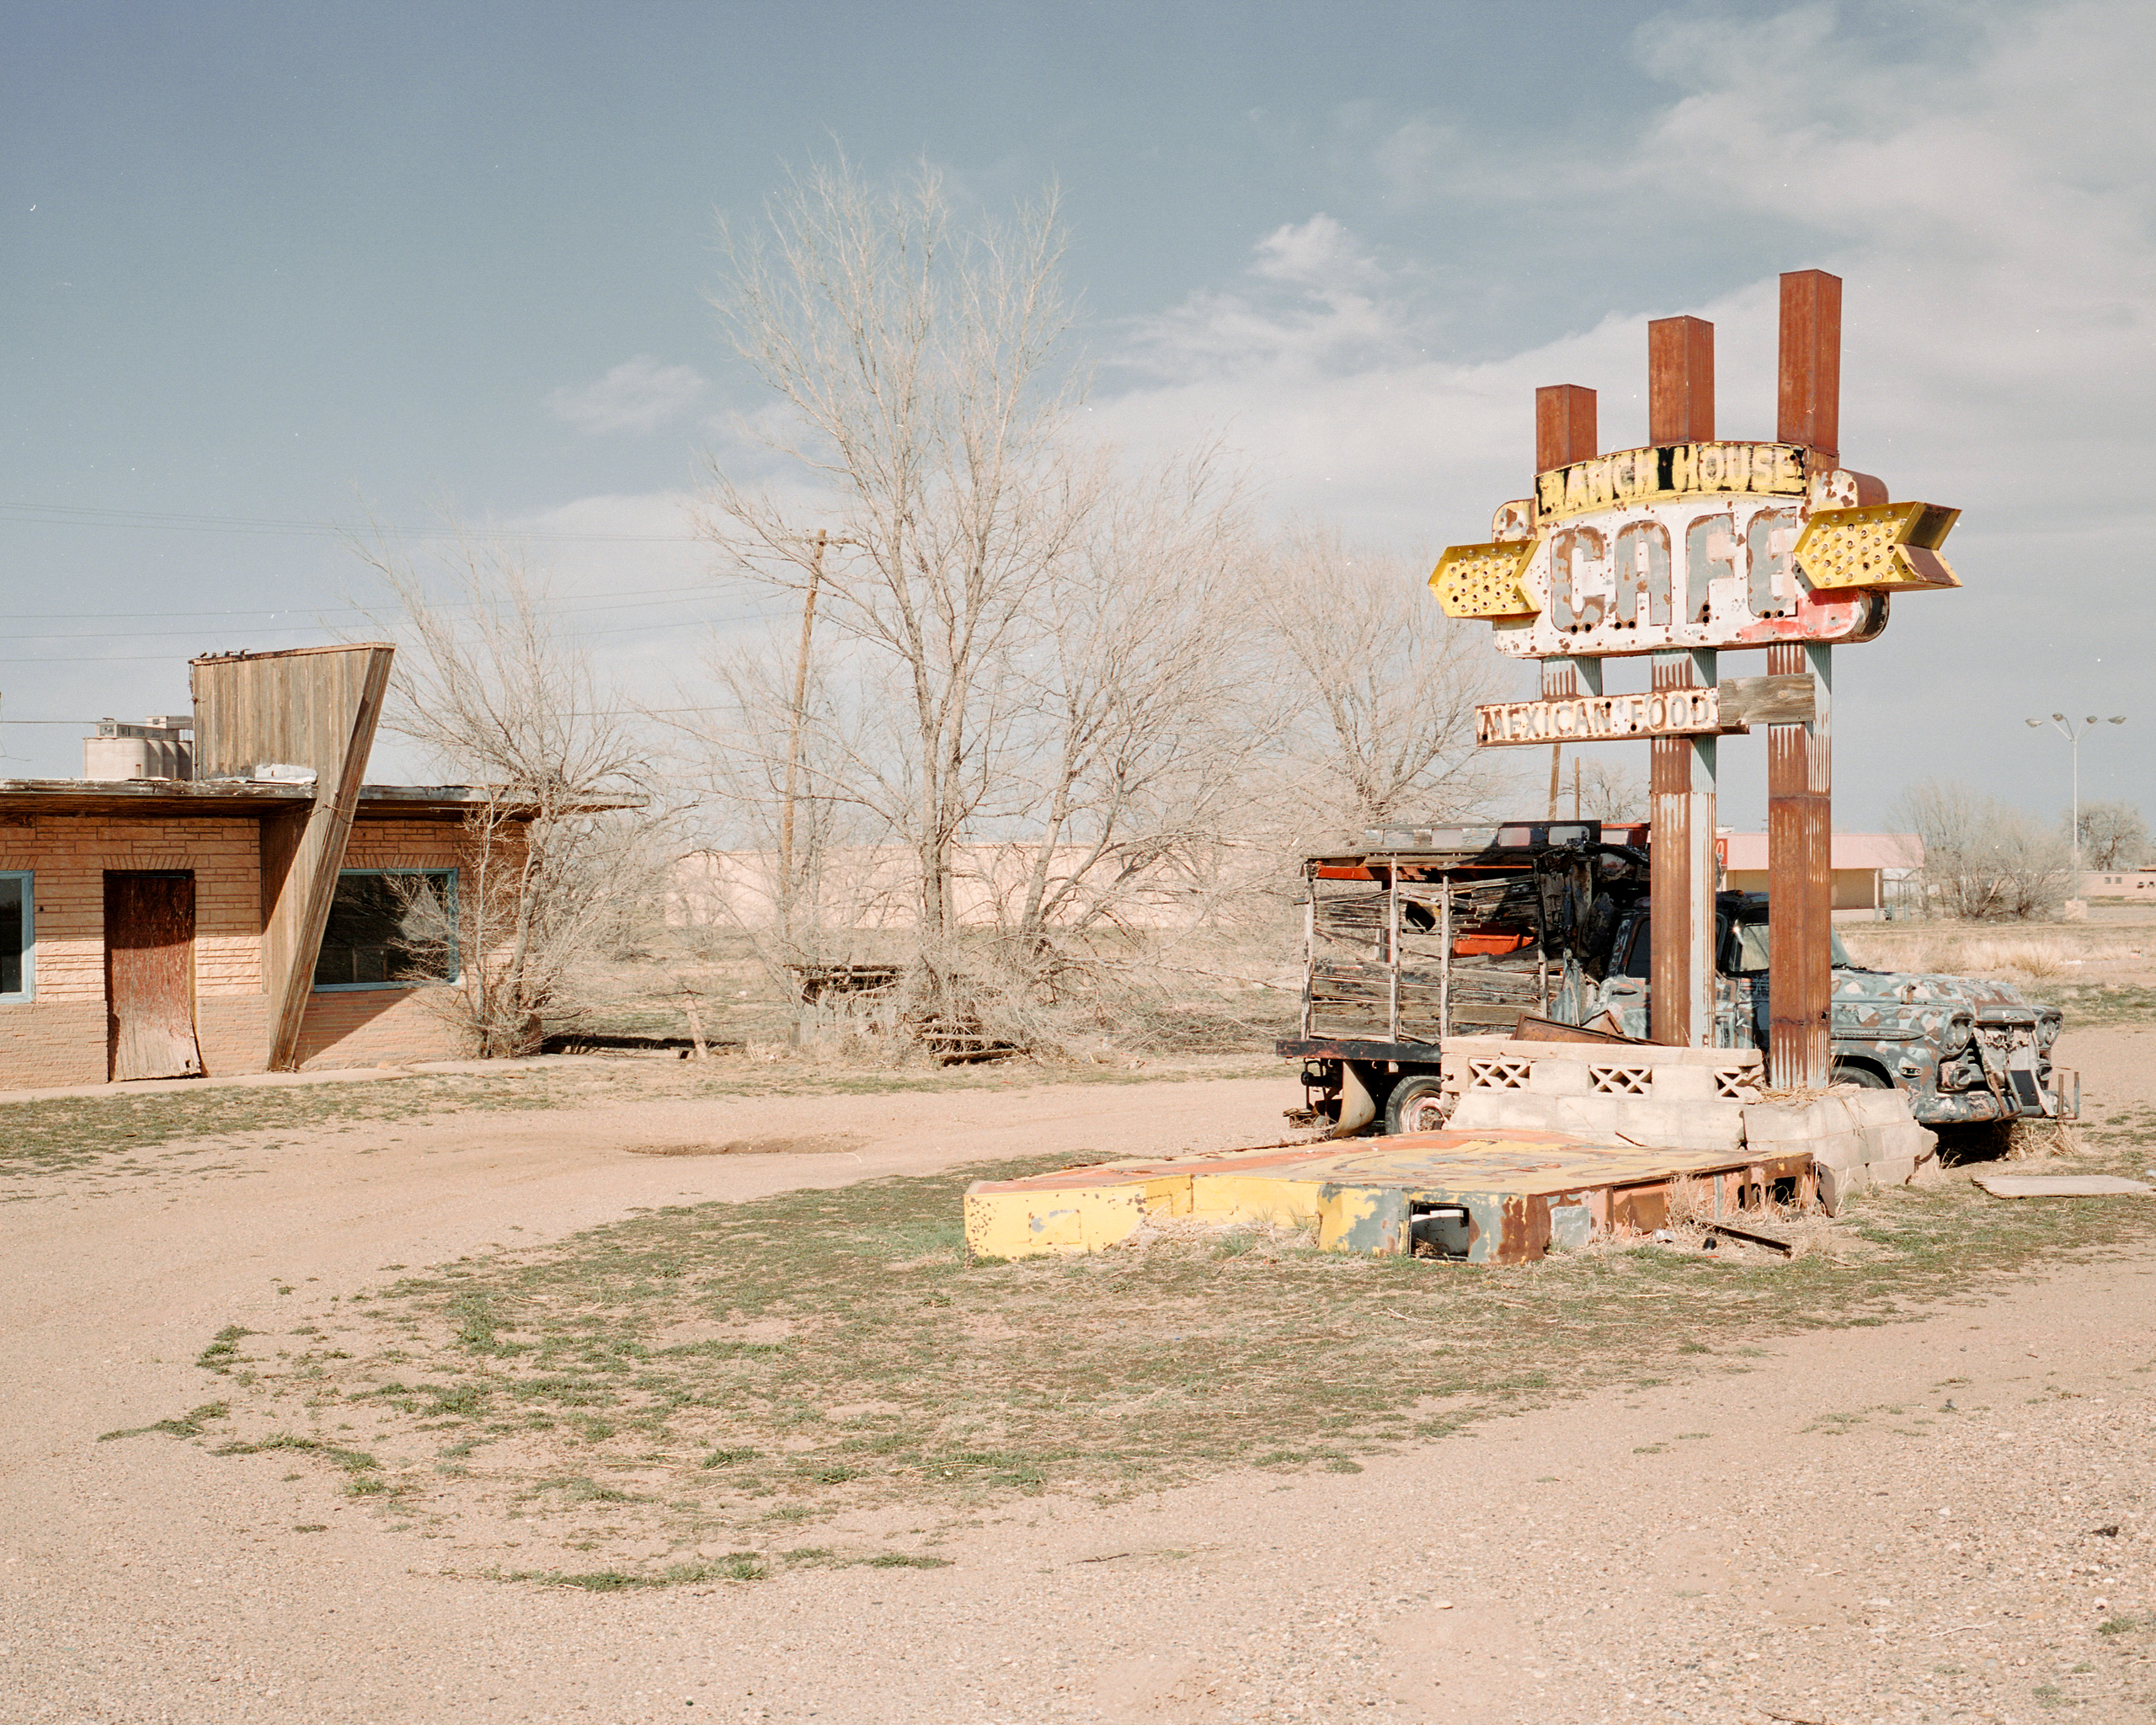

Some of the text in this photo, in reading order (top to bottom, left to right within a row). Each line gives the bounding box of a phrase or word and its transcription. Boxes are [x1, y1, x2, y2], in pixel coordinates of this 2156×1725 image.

[1540, 444, 1803, 515] RANCH HOUSE
[1550, 506, 1798, 633] CAFE
[1479, 693, 1710, 741] MEXICAN FOOD
